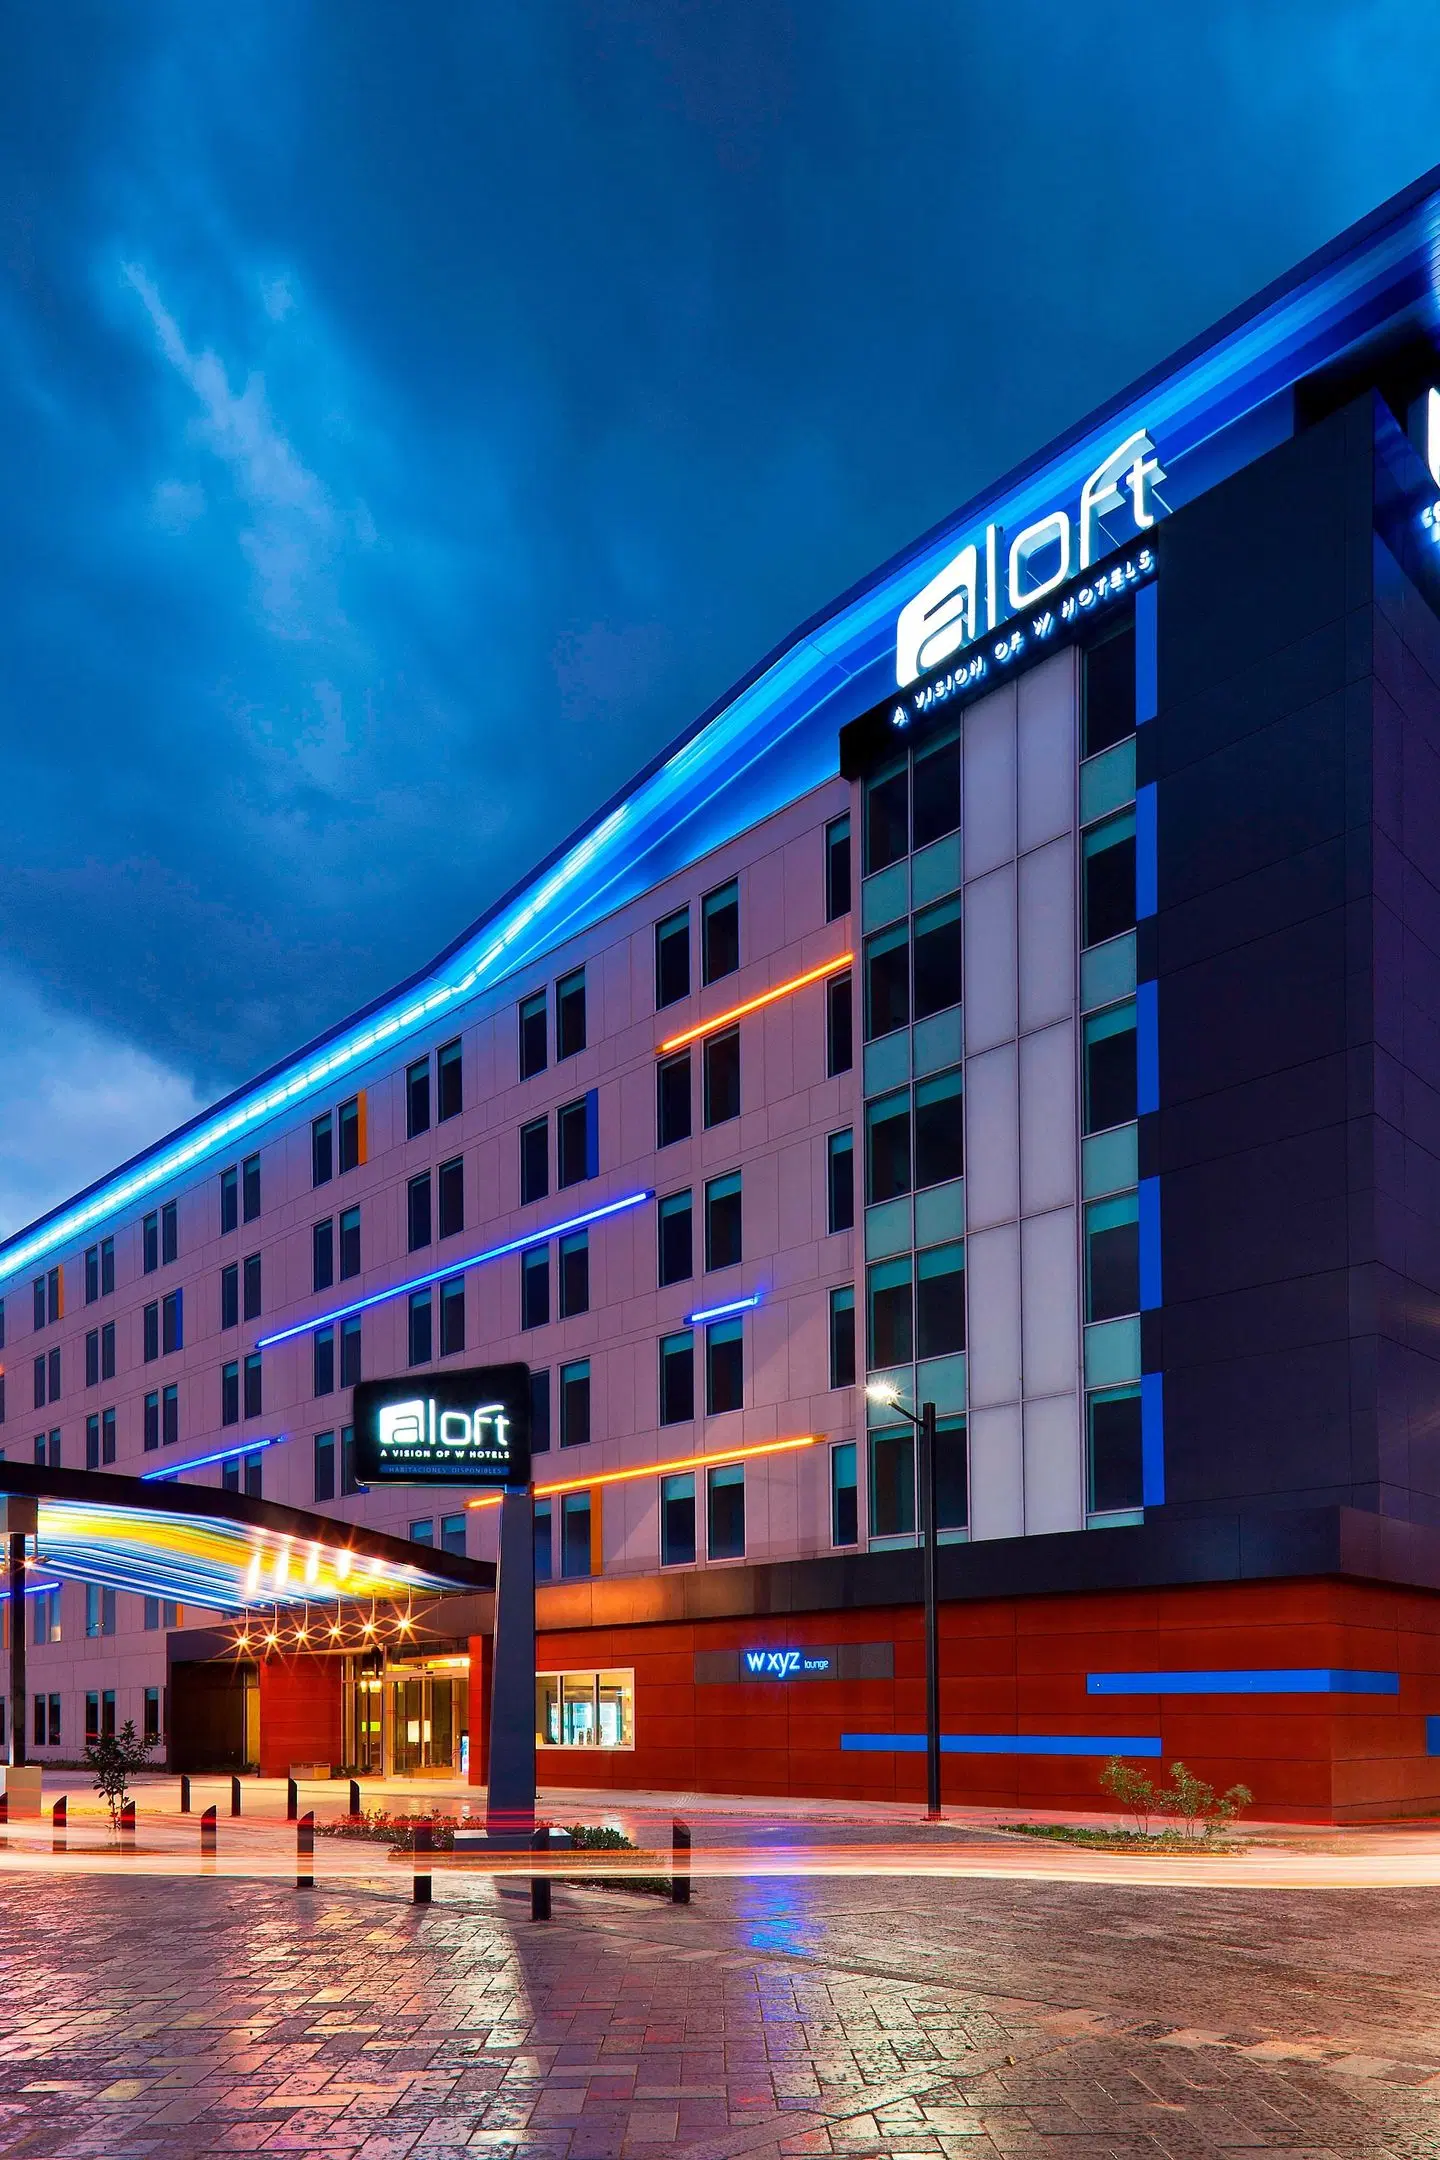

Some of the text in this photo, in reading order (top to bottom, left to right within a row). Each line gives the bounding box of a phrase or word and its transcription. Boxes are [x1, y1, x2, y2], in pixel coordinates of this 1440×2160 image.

[896, 428, 1166, 688] aloft
[892, 549, 1155, 725] A VISION OF W HOTELS
[379, 1398, 510, 1446] aloft
[380, 1449, 510, 1459] A VISION OF W HOTELS
[804, 1660, 829, 1671] lounge
